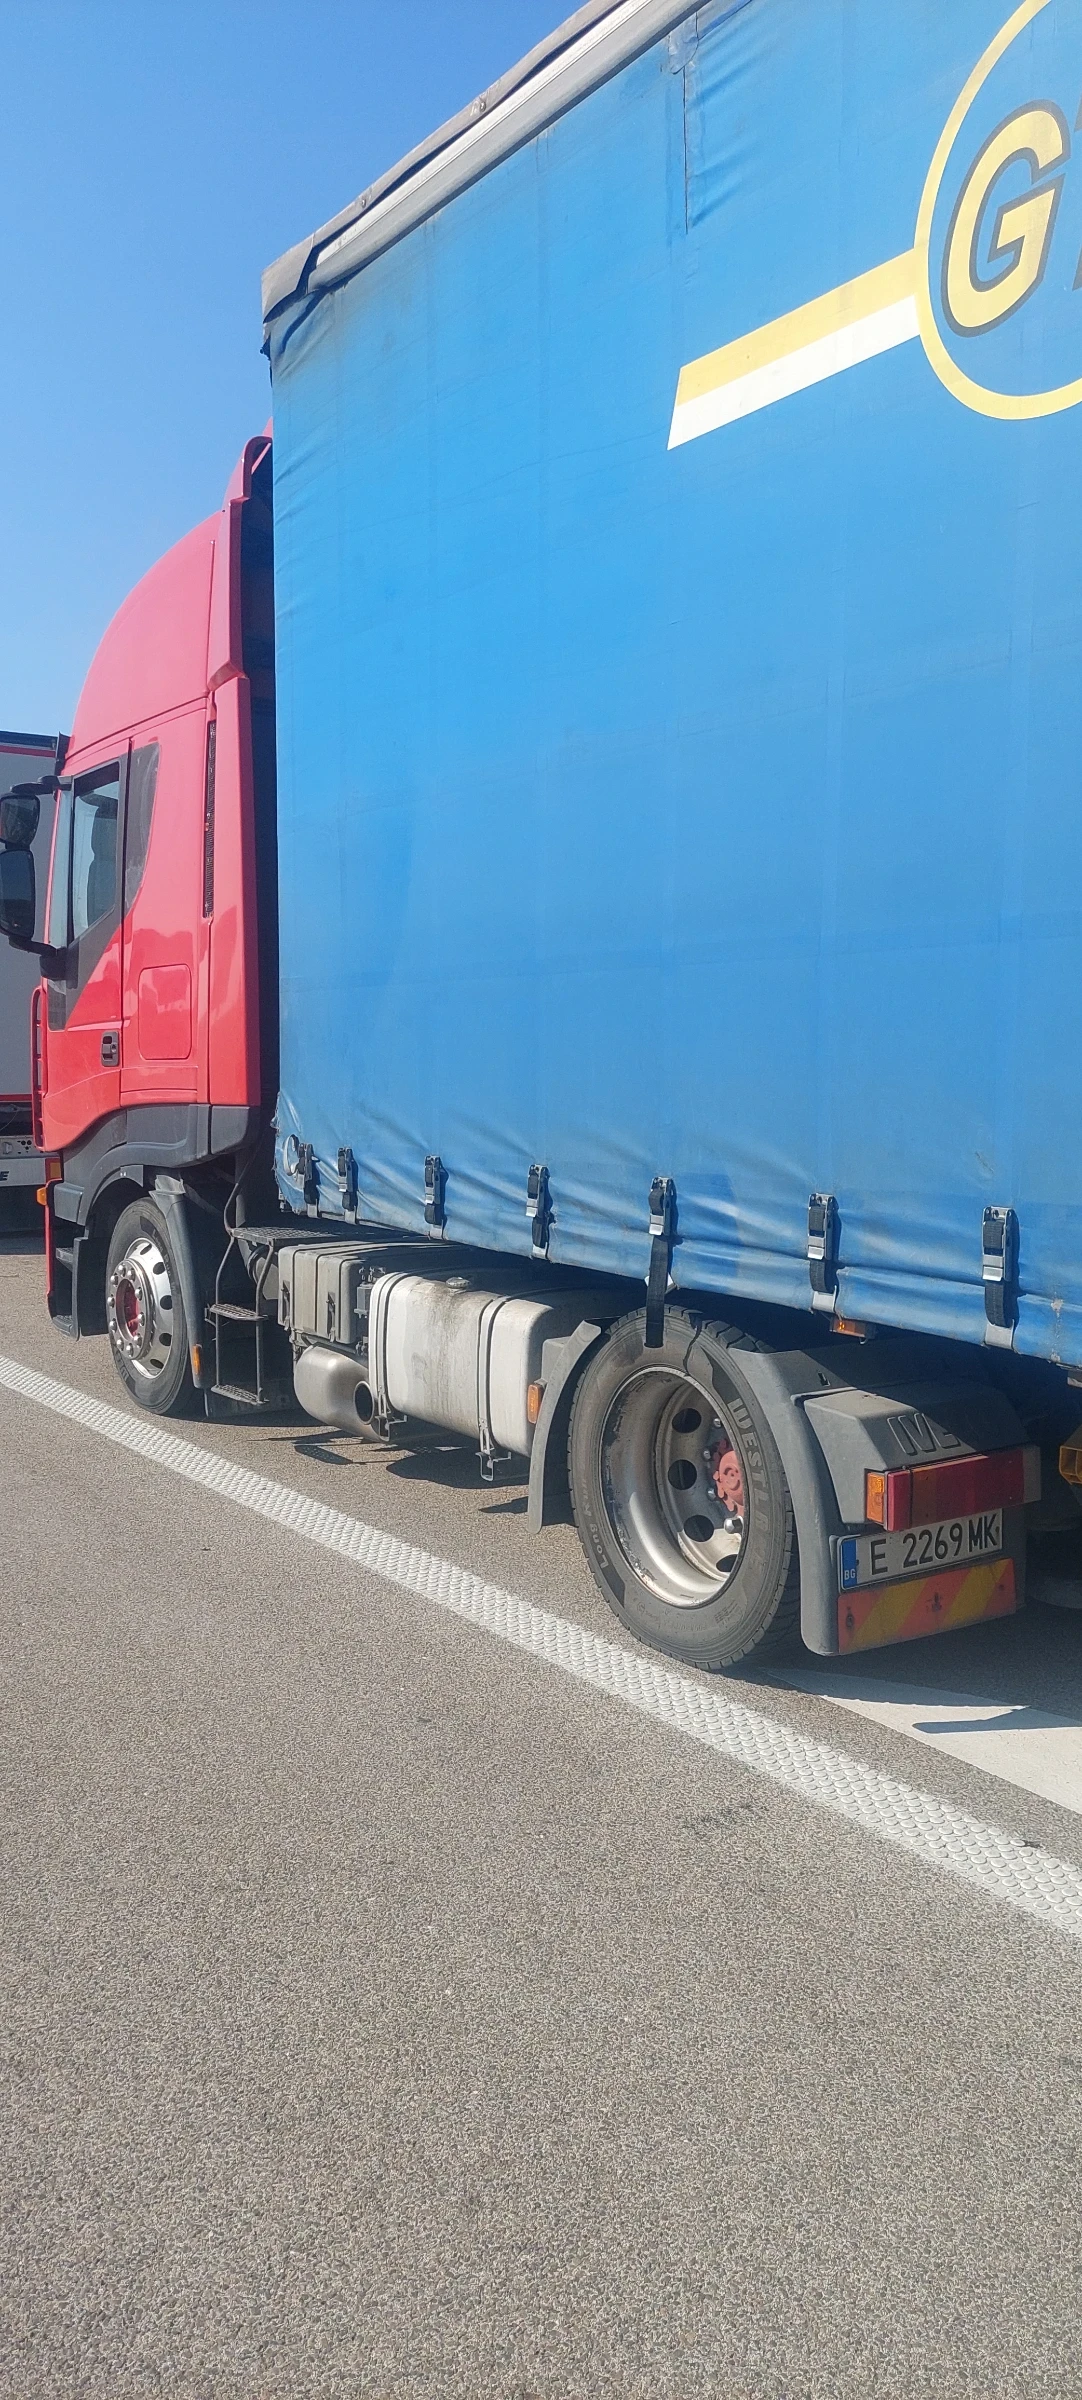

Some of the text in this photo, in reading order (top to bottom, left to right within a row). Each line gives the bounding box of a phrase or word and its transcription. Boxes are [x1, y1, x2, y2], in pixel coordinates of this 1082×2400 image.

[941, 86, 1082, 338] G
[588, 1522, 609, 1569] Long
[870, 1513, 998, 1576] E 2269 MK
[844, 1568, 856, 1581] BG
